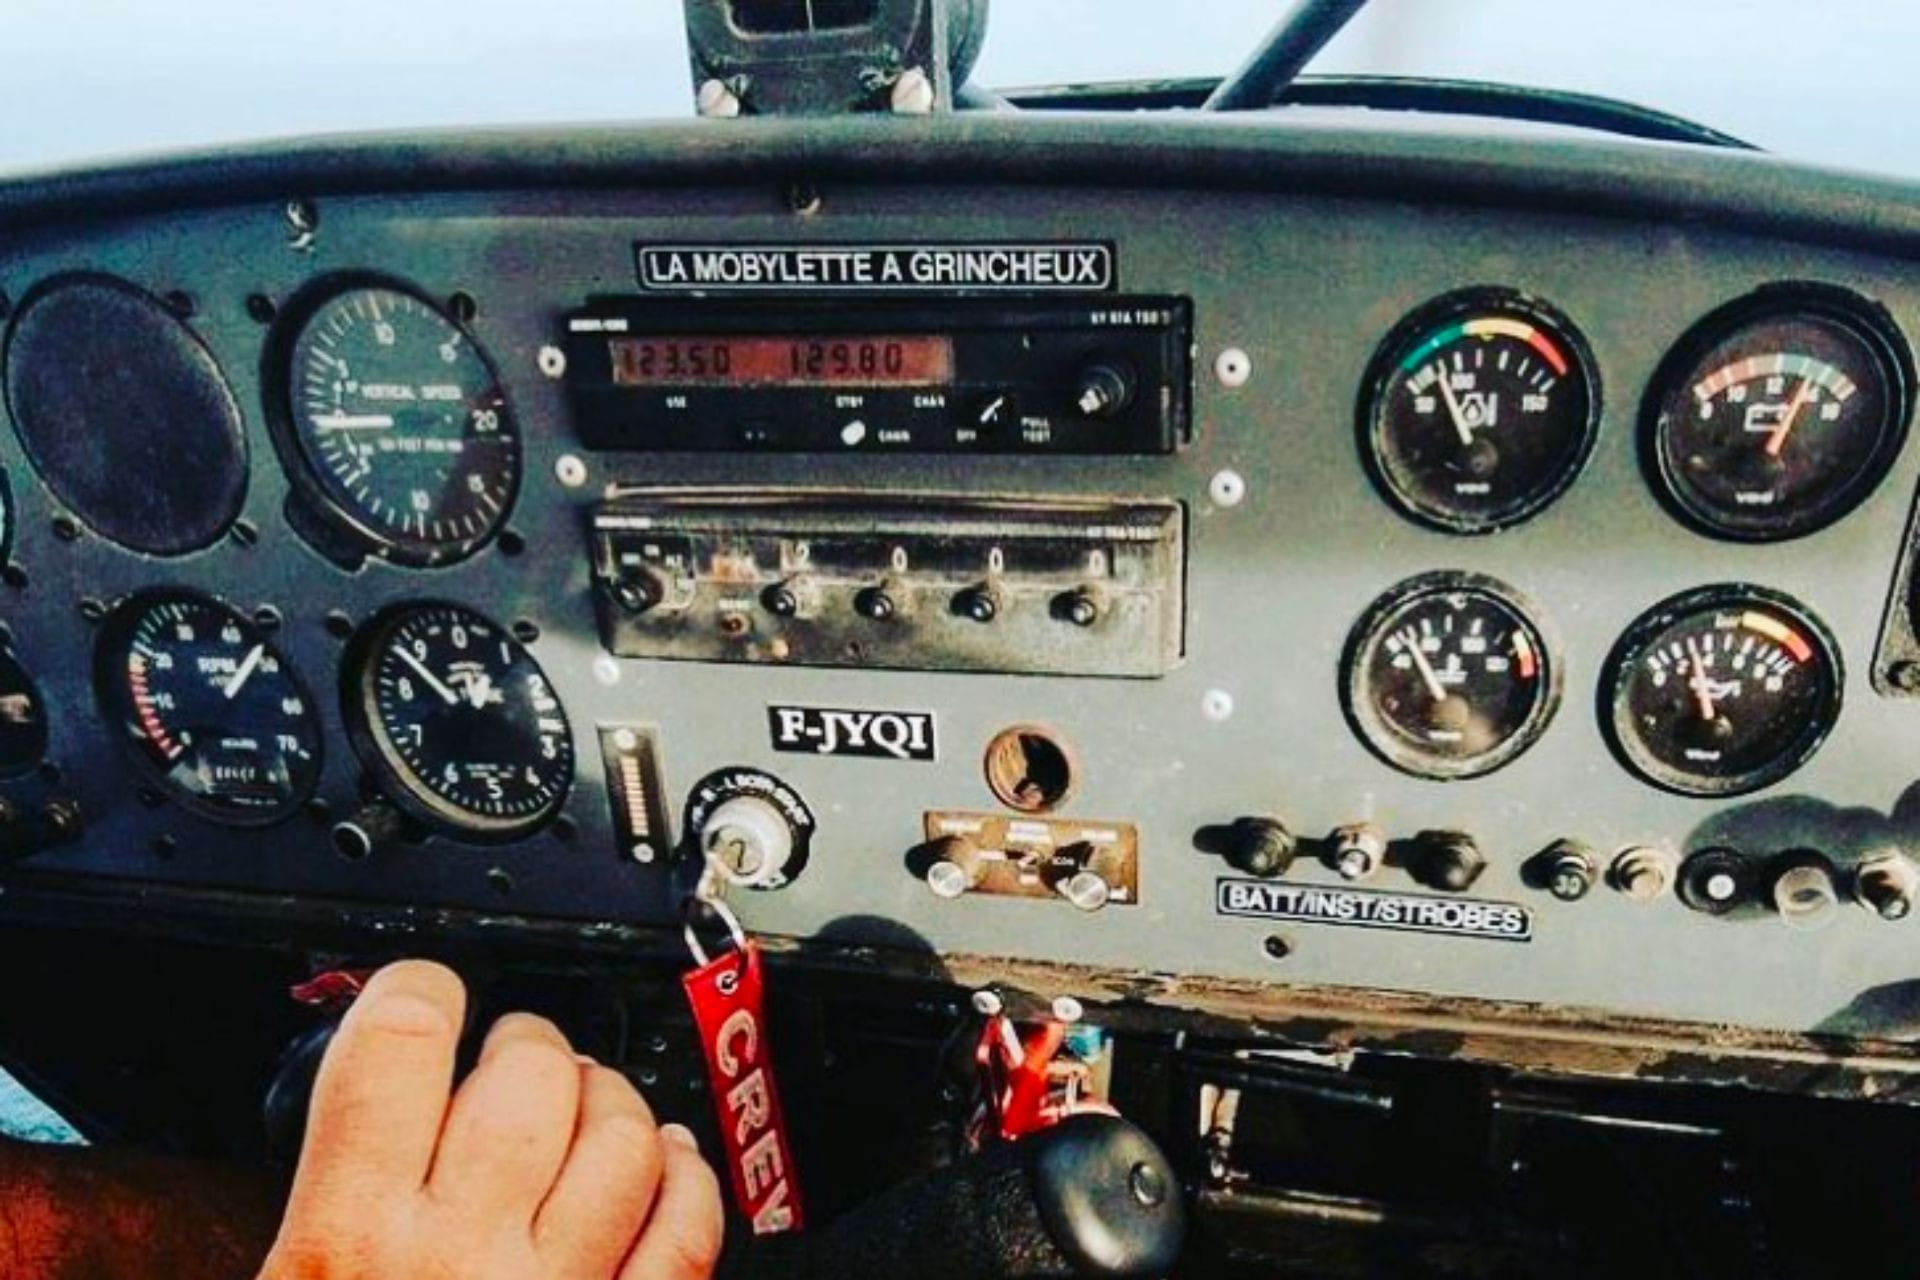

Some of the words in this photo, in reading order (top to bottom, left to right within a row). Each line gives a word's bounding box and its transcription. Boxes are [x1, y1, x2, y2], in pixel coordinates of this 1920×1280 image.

[650, 252, 688, 282] LA
[692, 252, 874, 282] MOBYLETTE
[881, 252, 902, 282] A
[909, 252, 1099, 282] GRINCHEUX
[472, 409, 499, 431] 20
[451, 625, 468, 650] 0
[413, 638, 428, 663] 9
[399, 677, 414, 701] 8
[408, 724, 422, 747] 7
[777, 708, 929, 760] F-JYQI
[488, 777, 504, 799] 5
[1228, 886, 1522, 932] BATT/INST/STROBES
